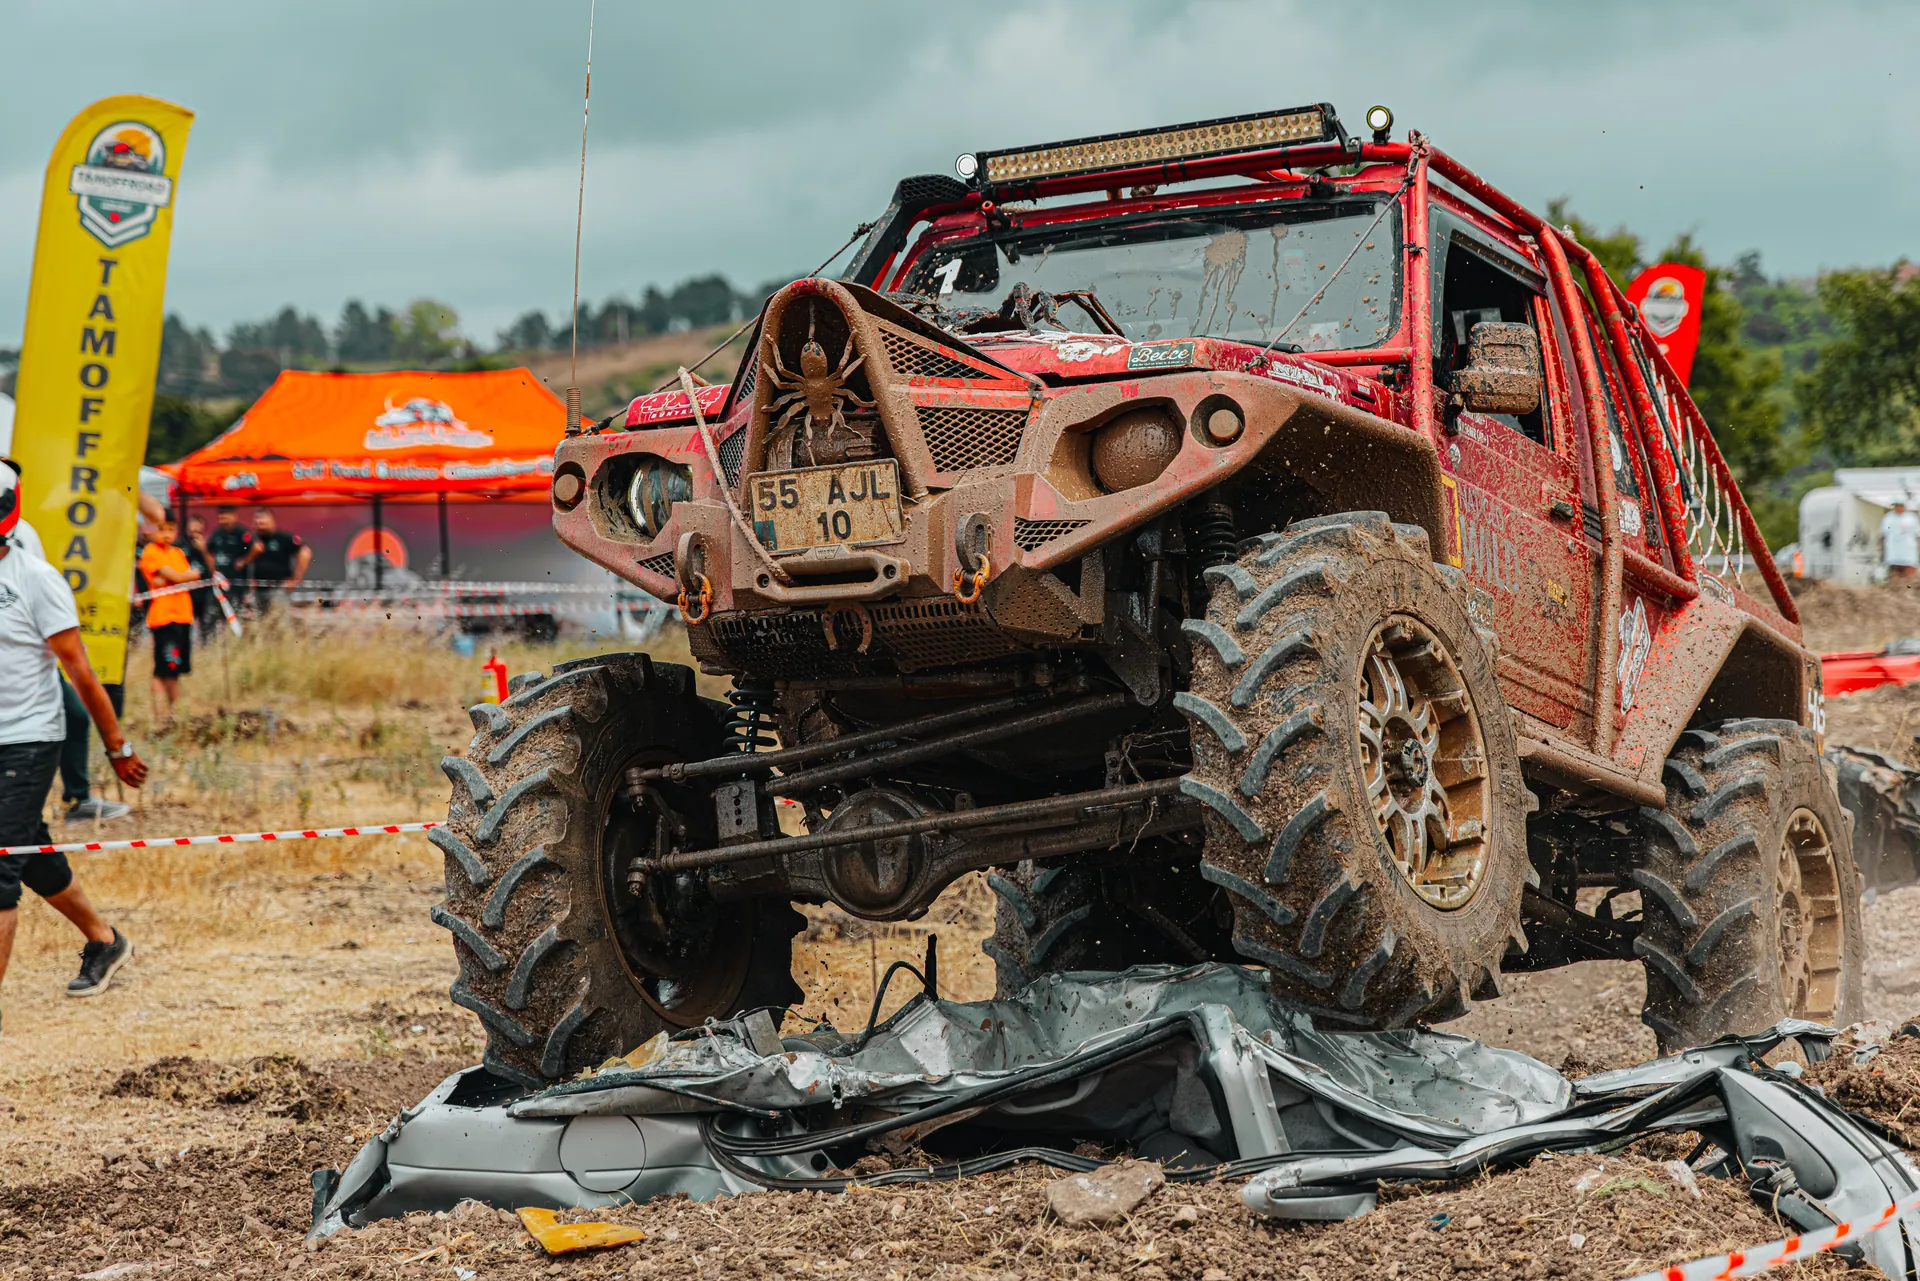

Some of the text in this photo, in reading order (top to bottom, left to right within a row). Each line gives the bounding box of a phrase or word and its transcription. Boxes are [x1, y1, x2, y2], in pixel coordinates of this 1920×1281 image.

[933, 258, 963, 295] 1
[63, 257, 119, 595] TAMOFFROAD
[758, 470, 891, 511] 55 AJL
[817, 509, 852, 542] 10
